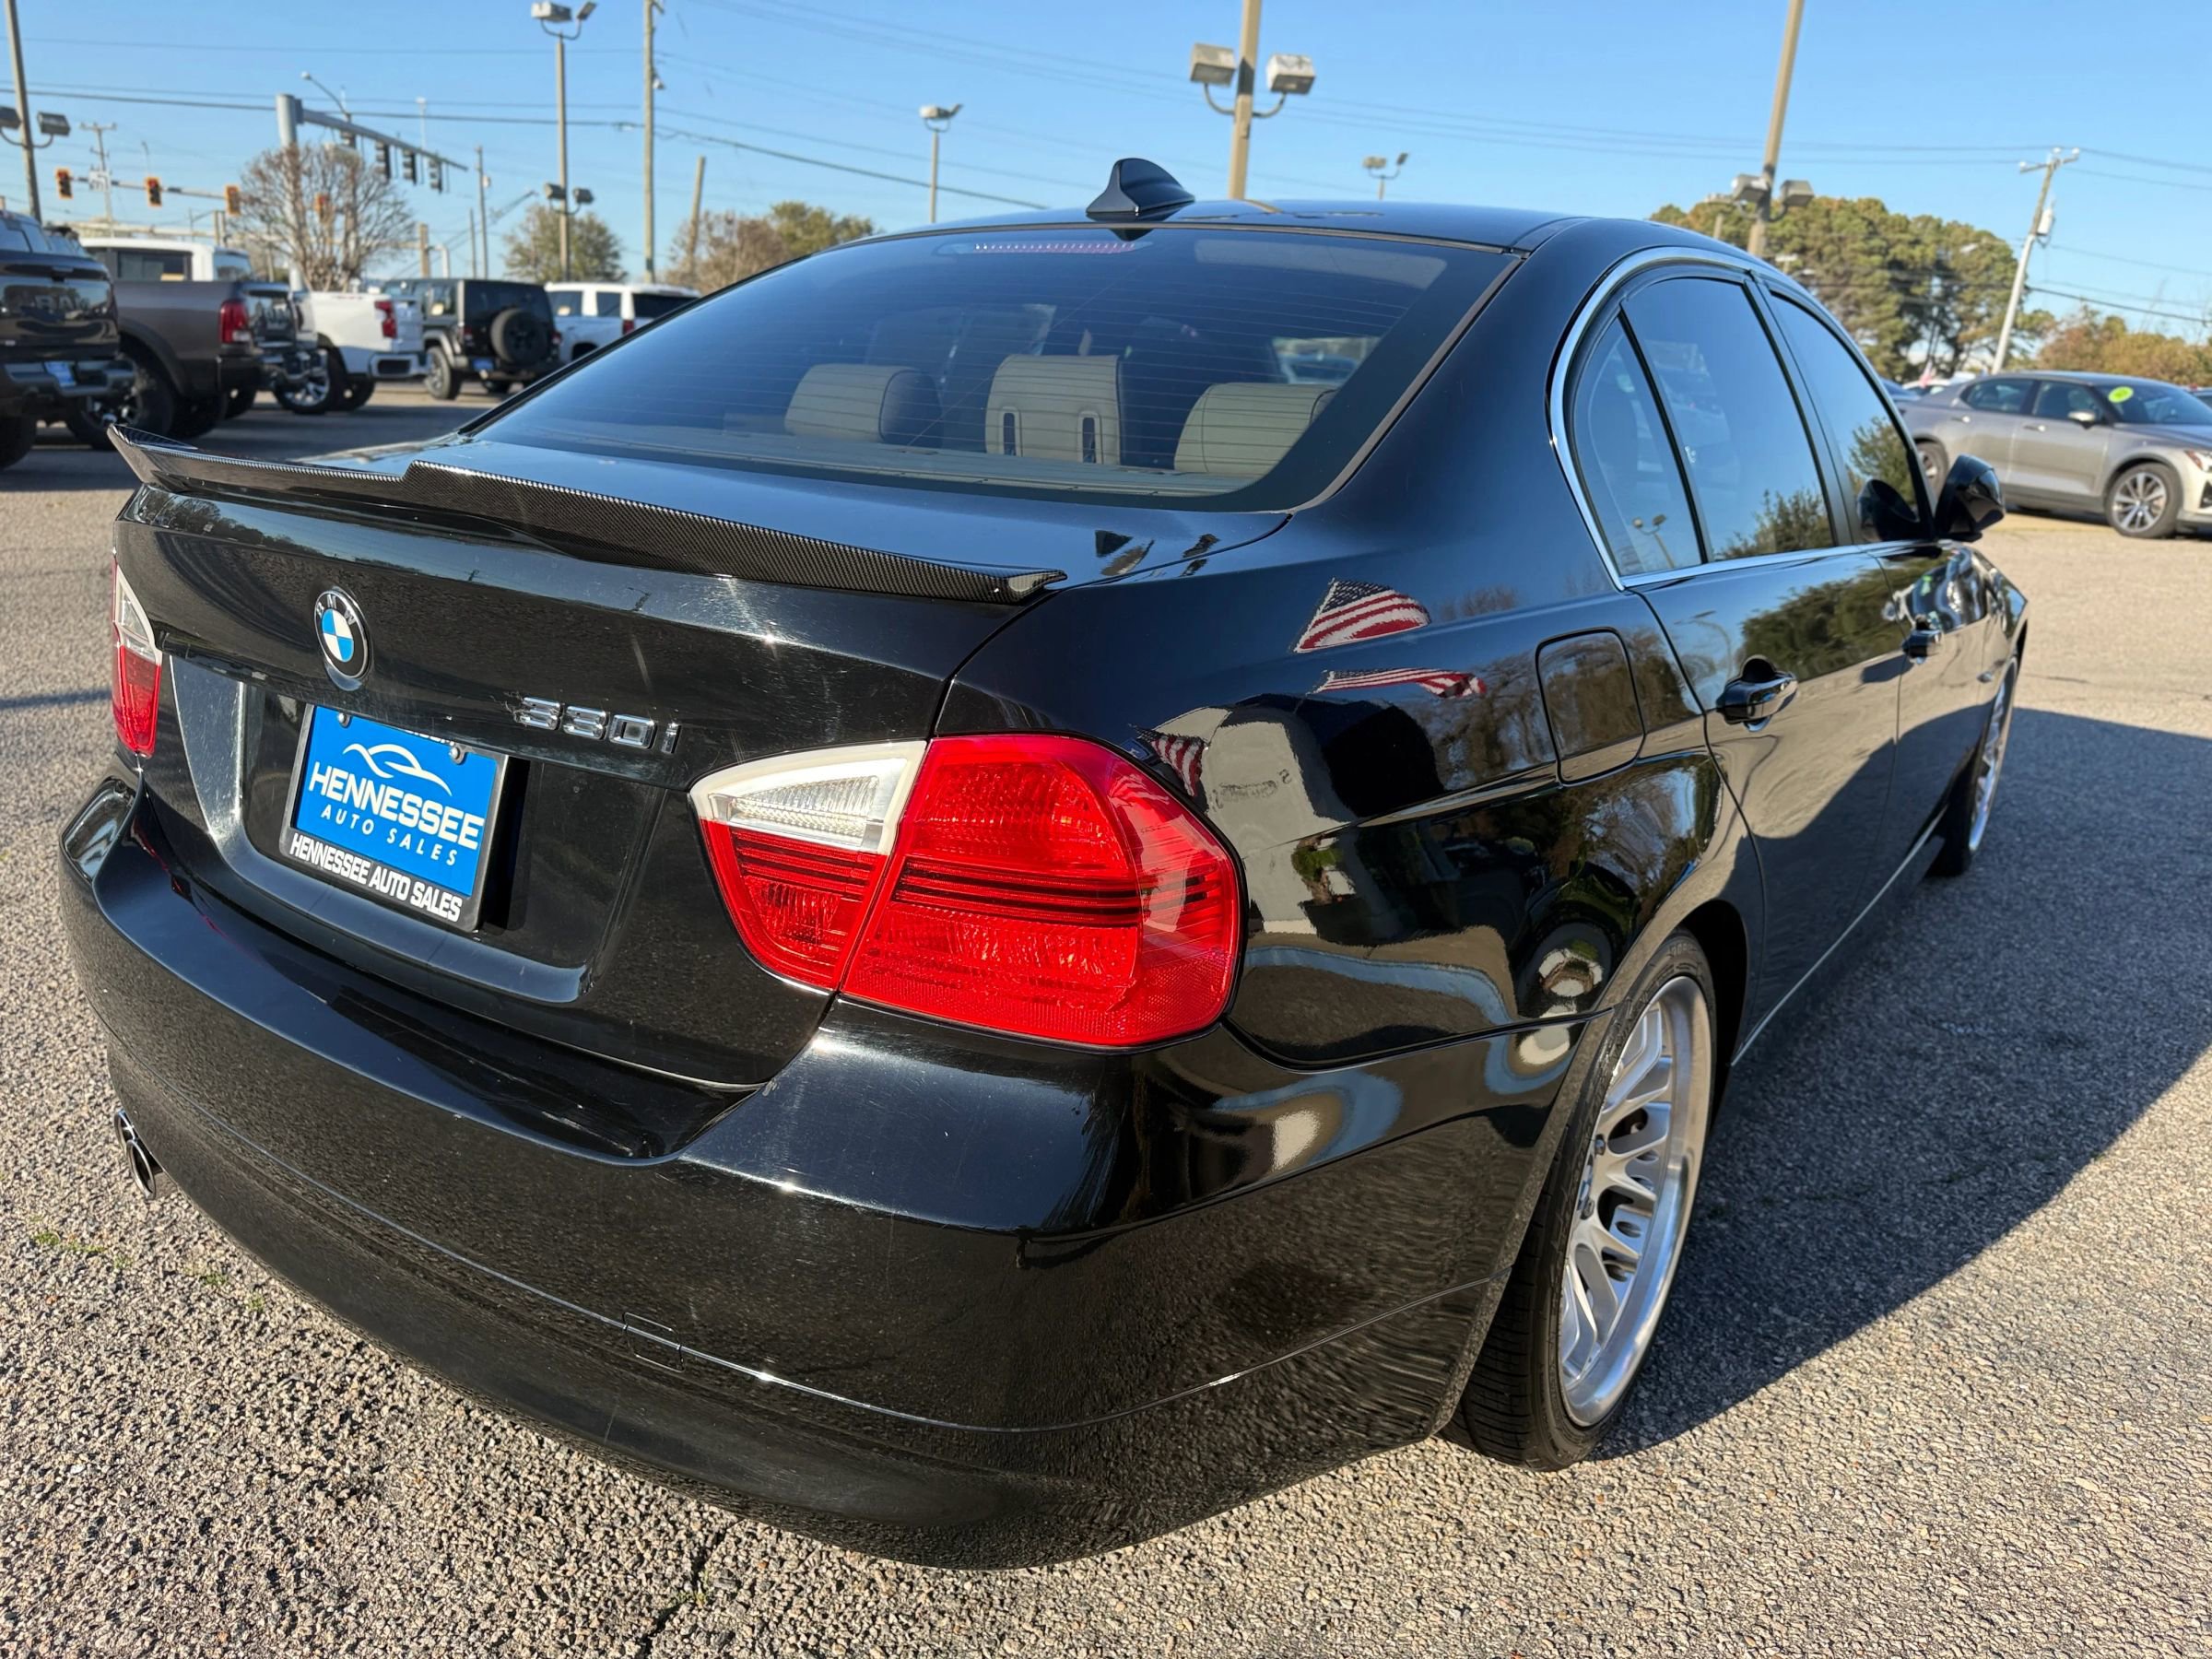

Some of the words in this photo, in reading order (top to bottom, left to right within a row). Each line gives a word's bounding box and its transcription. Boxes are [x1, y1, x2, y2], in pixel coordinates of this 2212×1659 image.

[316, 594, 357, 626] BMW
[520, 696, 681, 754] 330i
[308, 761, 485, 850] HENNESSEE
[321, 804, 374, 835] AUTO
[386, 828, 457, 866] SALES
[289, 832, 371, 885] HENNESSEE
[369, 865, 411, 901] AUTO
[410, 881, 463, 923] SALES
